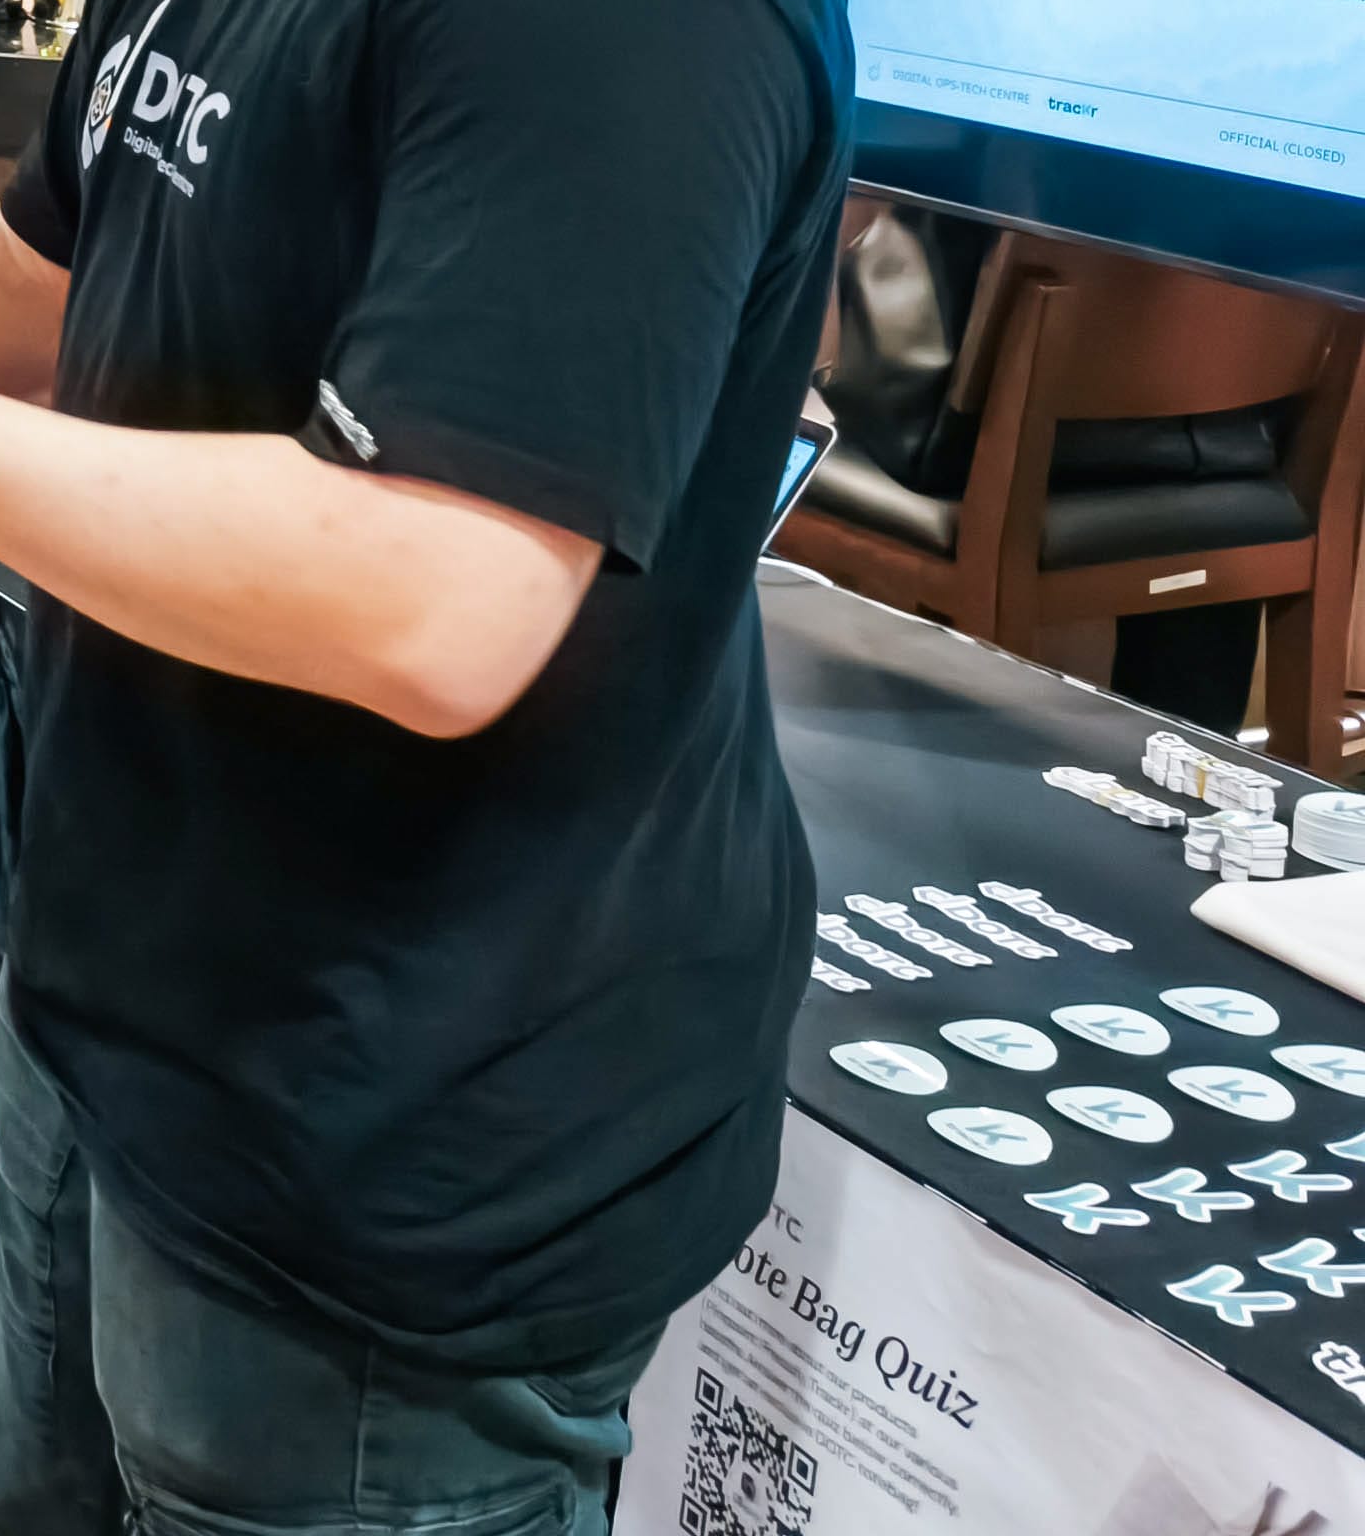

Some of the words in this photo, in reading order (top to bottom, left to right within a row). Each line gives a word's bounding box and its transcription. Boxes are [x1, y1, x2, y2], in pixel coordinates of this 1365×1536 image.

[132, 50, 230, 164] DTC
[893, 70, 932, 87] DIGITAL
[936, 78, 987, 96] OPS-TECH
[990, 88, 1030, 104] CENTRE
[1219, 129, 1280, 153] OFFICIAL
[1283, 141, 1346, 165] (CLOSED)
[790, 1275, 866, 1362] Bag
[875, 1336, 978, 1429] Quiz
[828, 1371, 850, 1392] our
[851, 1390, 918, 1438] products
[815, 1427, 855, 1469] DOTC
[842, 1428, 886, 1465] below
[877, 1428, 901, 1451] our
[905, 1447, 960, 1491] various
